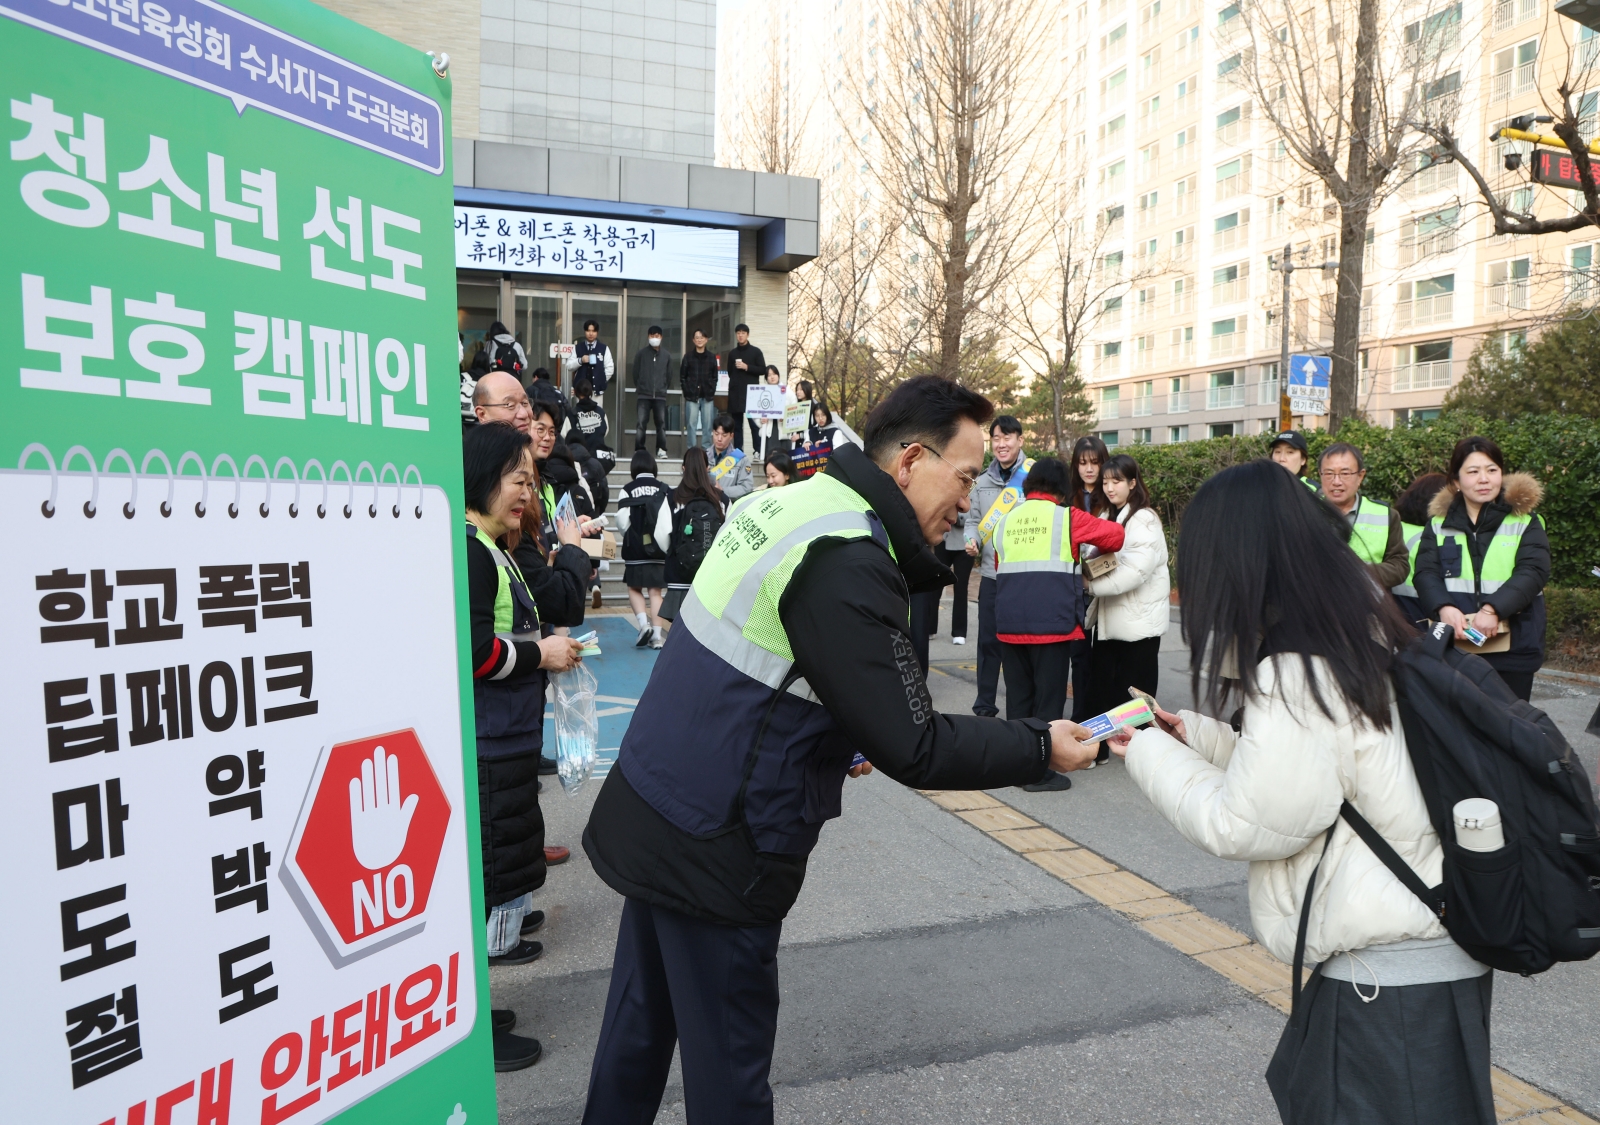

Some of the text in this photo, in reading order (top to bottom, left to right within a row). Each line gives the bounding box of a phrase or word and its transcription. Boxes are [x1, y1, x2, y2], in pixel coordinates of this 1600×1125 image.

[240, 43, 340, 110] 수서지구
[347, 86, 429, 149] 도곡분회
[10, 93, 426, 301] 청소년 선도
[497, 218, 511, 236] &
[518, 218, 576, 244] 헤드폰
[583, 223, 656, 250] 착용금지
[467, 240, 624, 273] 휴대전화 이용금지
[20, 273, 430, 432] 보호 캠페인
[1291, 386, 1326, 397] 일방통행
[35, 561, 312, 648] 학교 폭력
[44, 651, 318, 763] 딥페이크
[890, 631, 926, 724] GORE-TEX
[352, 864, 415, 936] NO
[260, 952, 460, 1125] 안돼요!
